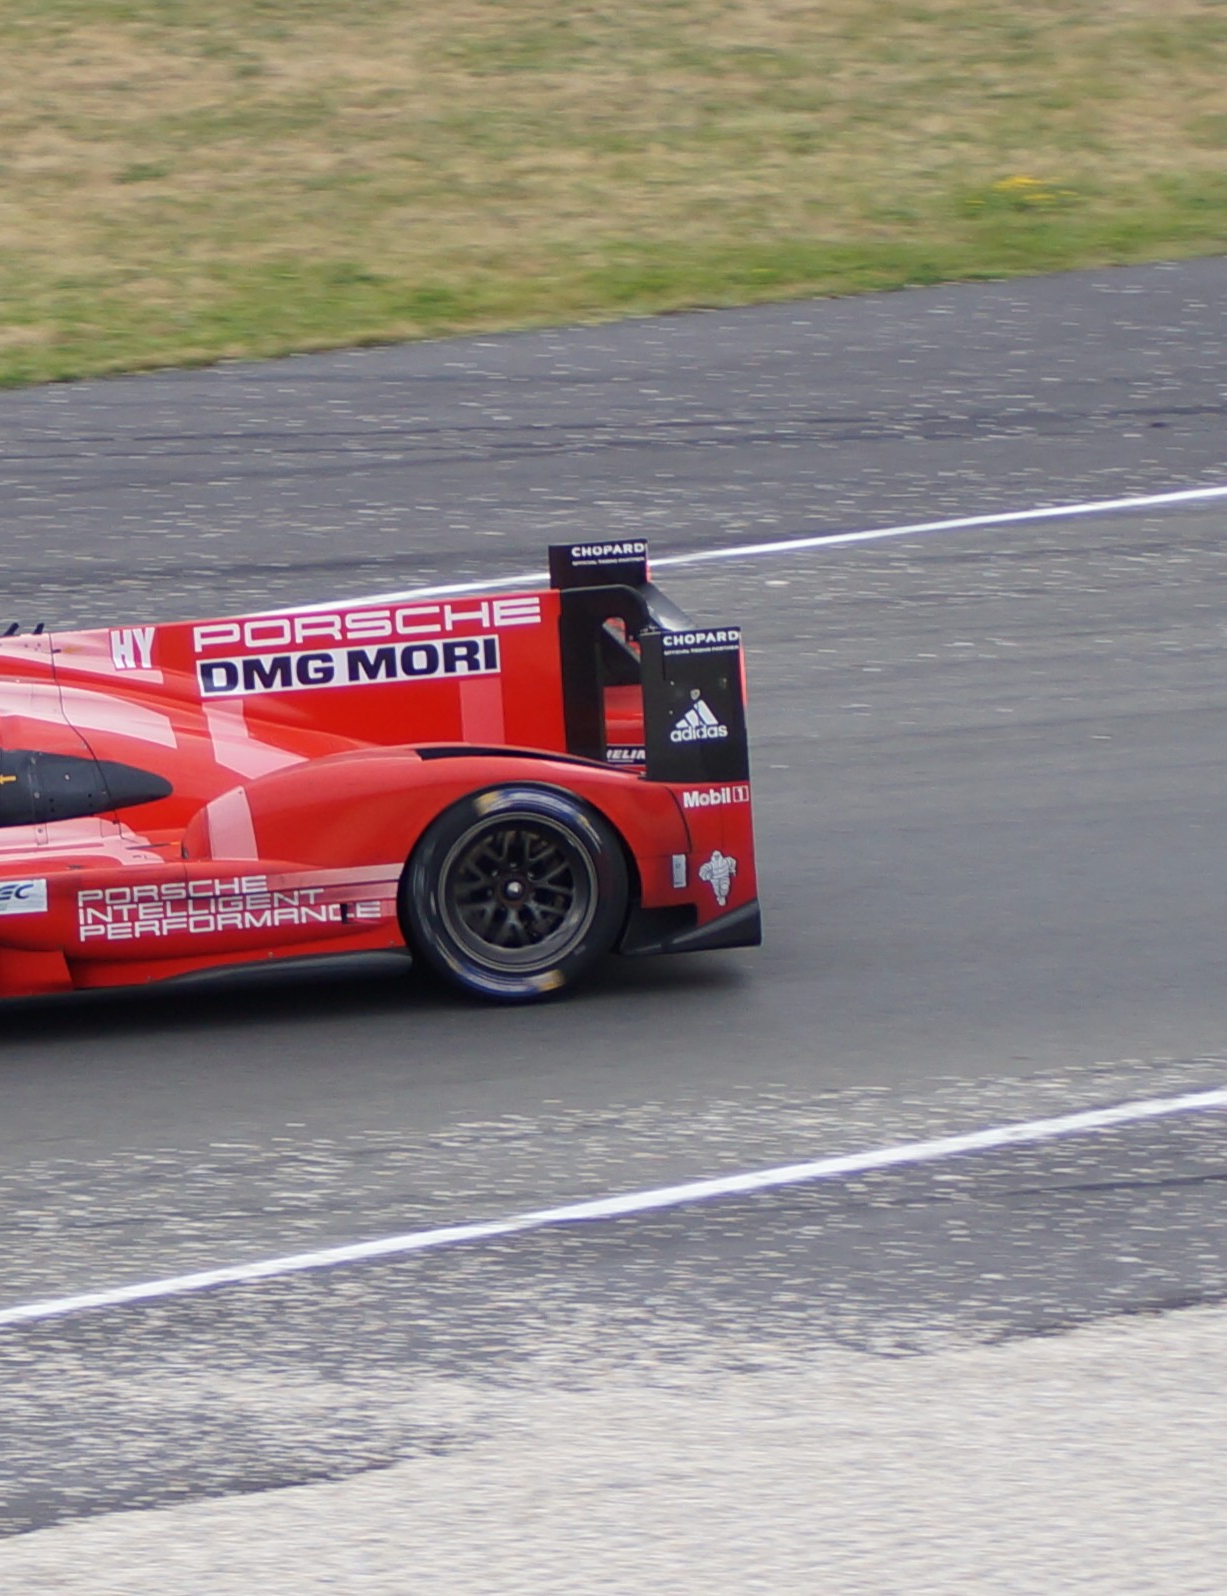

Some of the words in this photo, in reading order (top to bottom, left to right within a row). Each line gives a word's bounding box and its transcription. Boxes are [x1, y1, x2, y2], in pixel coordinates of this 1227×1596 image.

[571, 542, 645, 557] CHOPARD
[193, 597, 541, 652] PORSCHE
[663, 630, 739, 646] CHOPARD
[110, 626, 156, 669] HY
[200, 652, 334, 693] DMG
[347, 638, 499, 681] MORI
[670, 724, 728, 742] adidas
[683, 786, 731, 808] Mobil
[78, 875, 267, 907] PORSCHE
[79, 888, 324, 925] INTELLIGENT
[79, 901, 381, 942] PERFORMANCE
